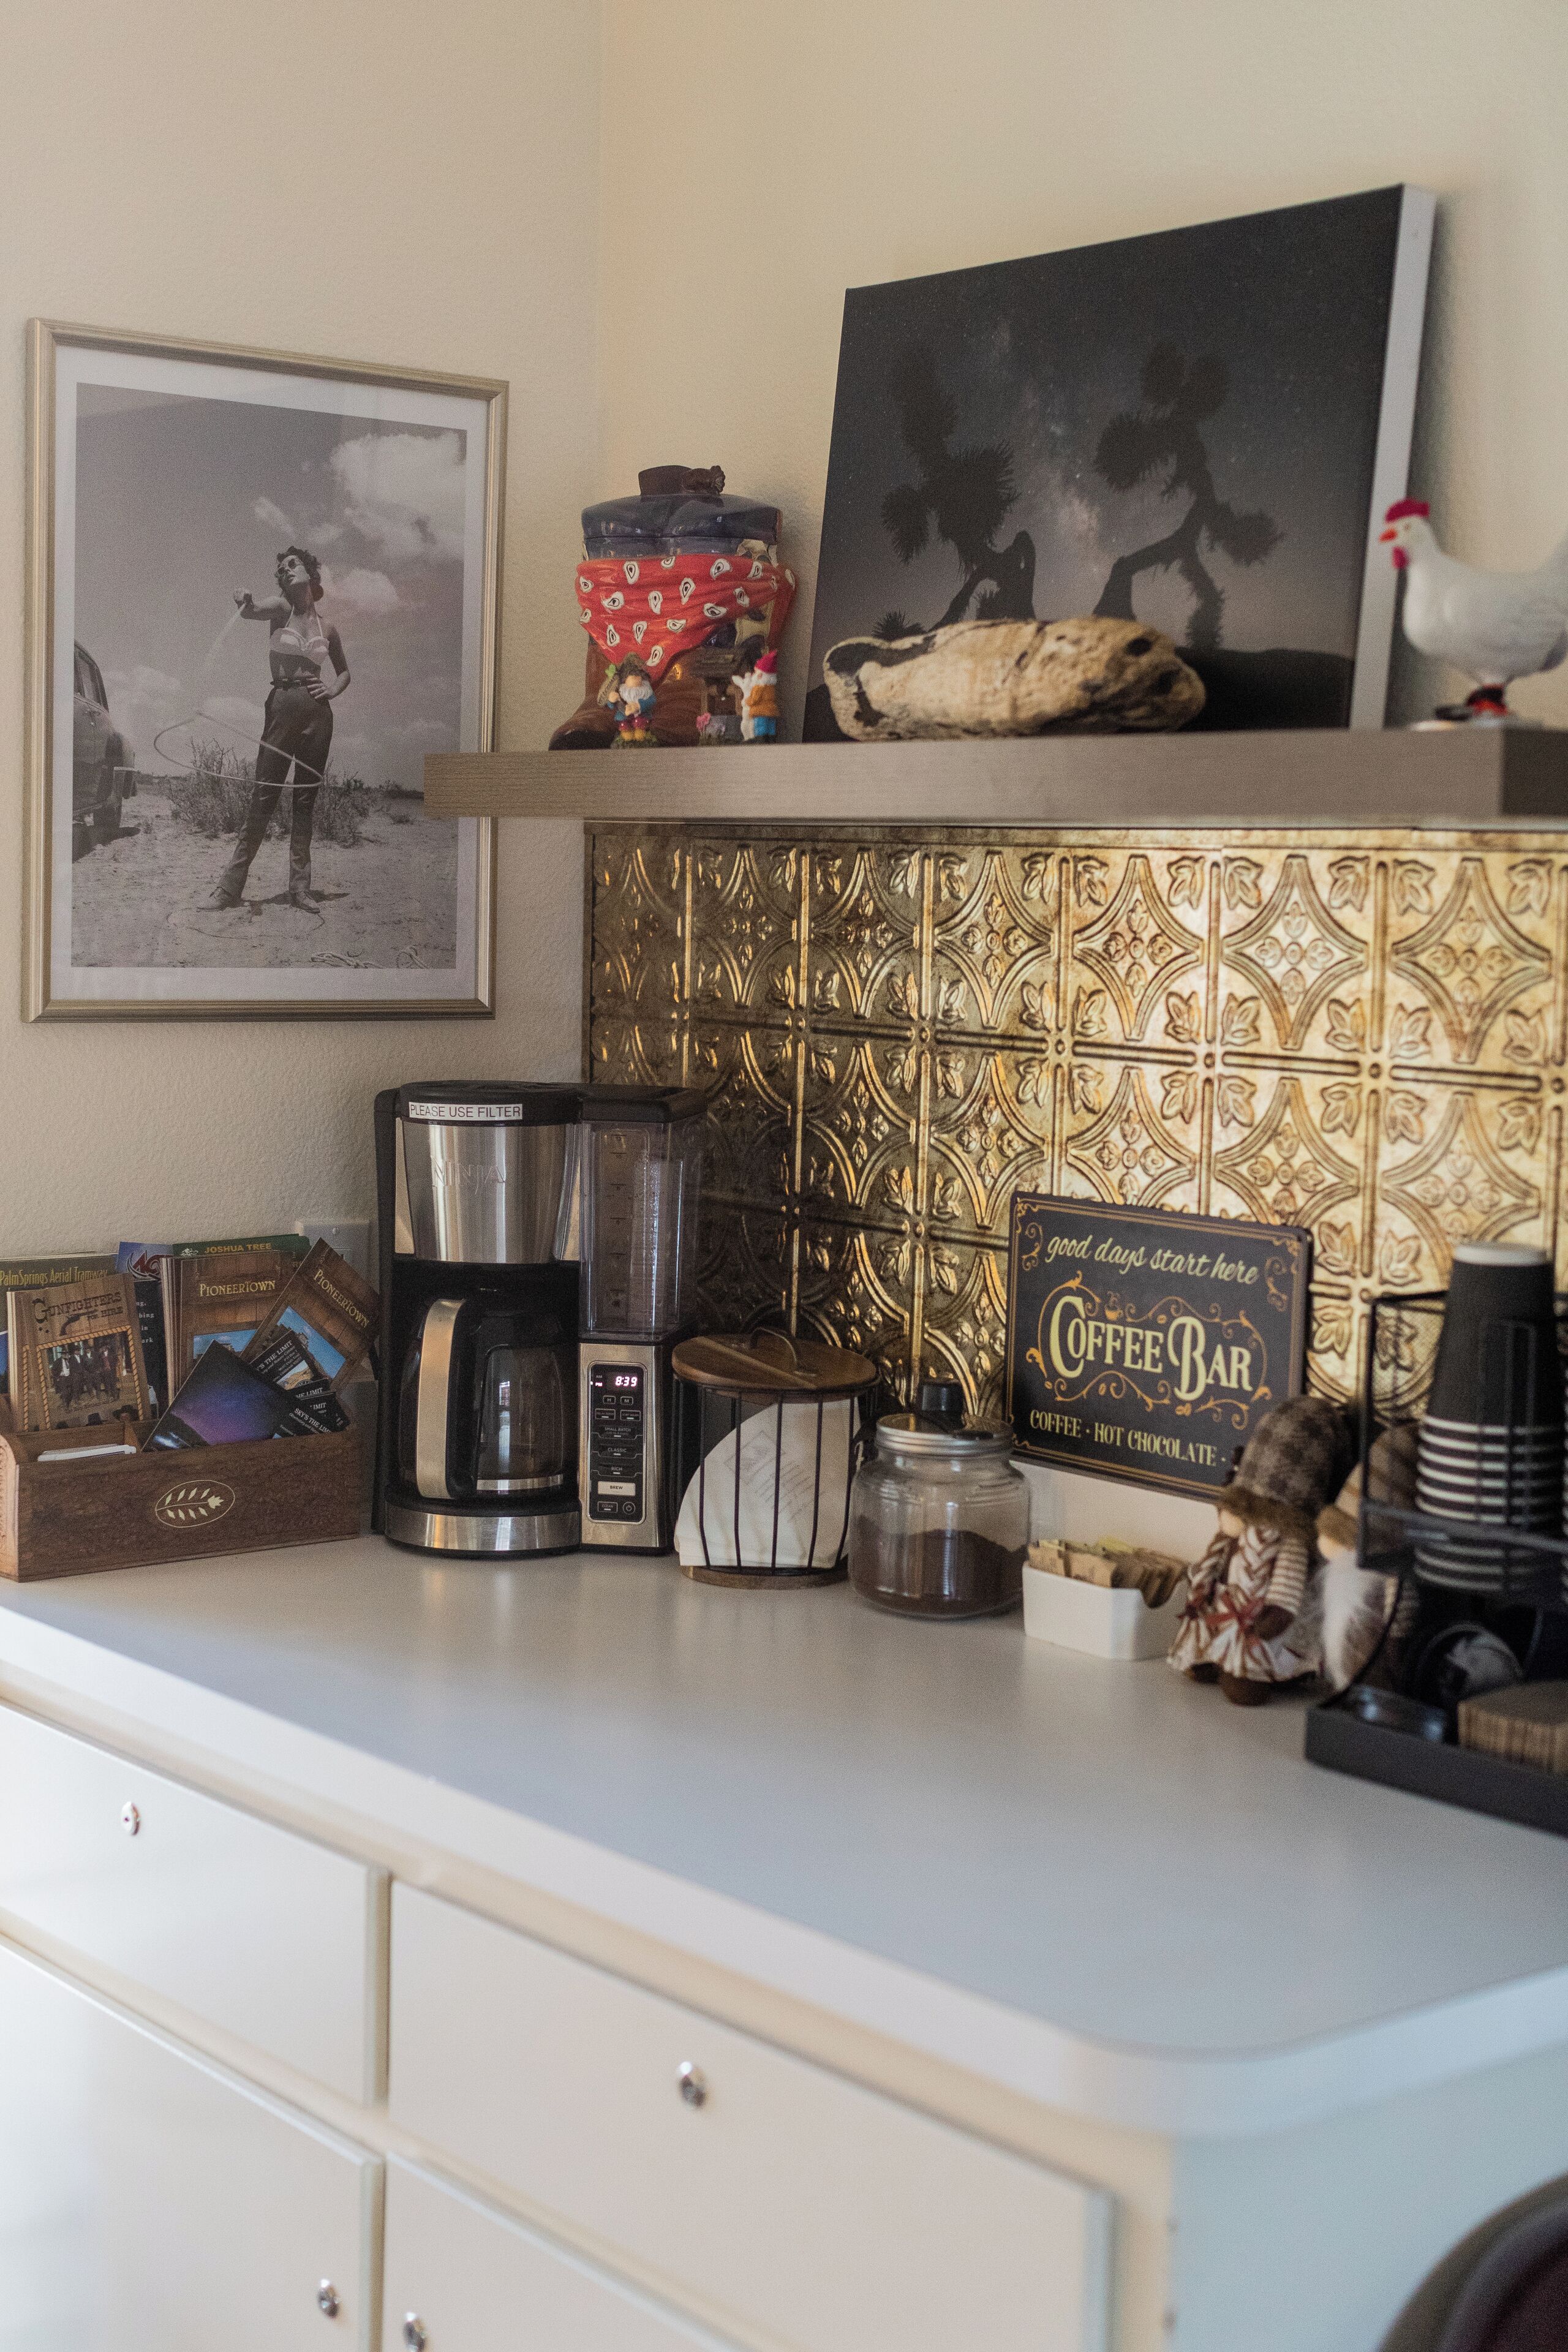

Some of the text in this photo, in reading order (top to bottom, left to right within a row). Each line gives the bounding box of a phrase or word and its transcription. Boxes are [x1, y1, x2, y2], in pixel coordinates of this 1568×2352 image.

[410, 1104, 521, 1118] PLEASE USE FILTER
[430, 1155, 506, 1195] NINJA
[204, 1244, 244, 1254] JOSHUA
[1045, 1235, 1259, 1284] good days start here
[0, 1270, 18, 1286] Palm
[19, 1269, 48, 1286] Springs
[50, 1267, 72, 1284] Aerial
[199, 1280, 276, 1297] PIONEERTOWN
[313, 1268, 370, 1328] PIONEERTOWN
[32, 1292, 122, 1324] GUNFIGHTERS
[100, 1306, 123, 1317] HIRE
[264, 1353, 277, 1365] THE
[277, 1340, 293, 1355] LIMIT
[1049, 1295, 1253, 1401] COFFEE BAR
[306, 1387, 323, 1396] LIMIT
[615, 1376, 638, 1387] 8:39
[294, 1408, 309, 1421] SKY'S
[308, 1417, 320, 1428] THE
[1030, 1409, 1218, 1467] COFFEE HOT CHOCOLATE
